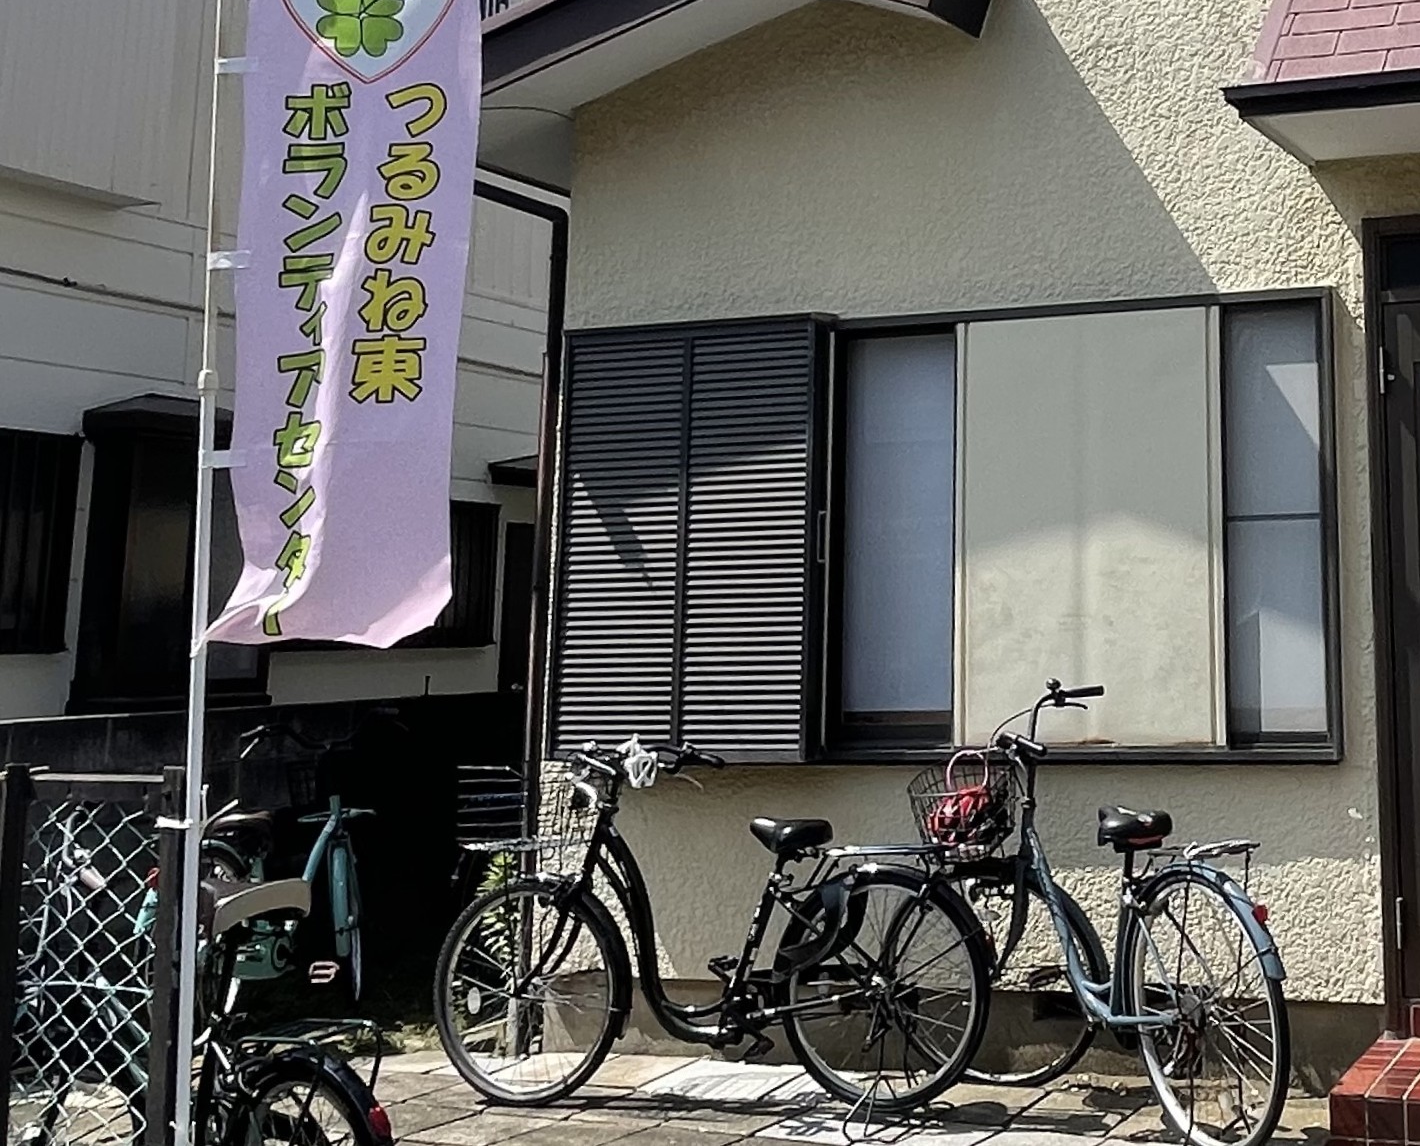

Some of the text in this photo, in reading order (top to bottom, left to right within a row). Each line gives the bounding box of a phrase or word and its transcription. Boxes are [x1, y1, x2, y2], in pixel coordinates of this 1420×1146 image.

[263, 81, 351, 636] ボランティアセンター
[348, 82, 447, 403] つるみね東
